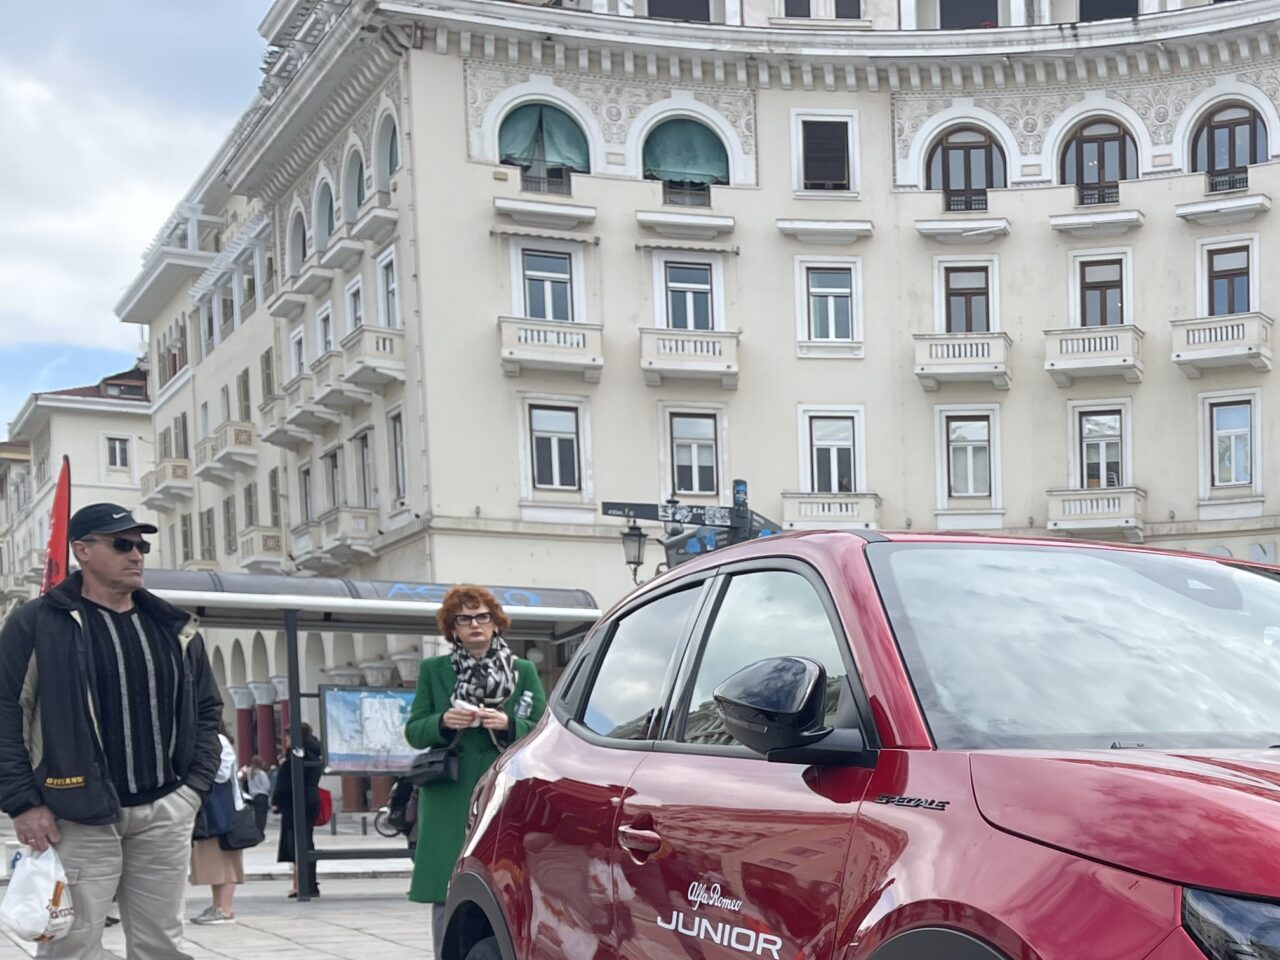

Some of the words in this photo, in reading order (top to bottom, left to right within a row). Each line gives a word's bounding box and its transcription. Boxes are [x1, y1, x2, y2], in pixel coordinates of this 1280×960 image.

[688, 881, 709, 911] Alfa
[708, 883, 743, 911] Romeo
[656, 910, 783, 960] JUNIOR
